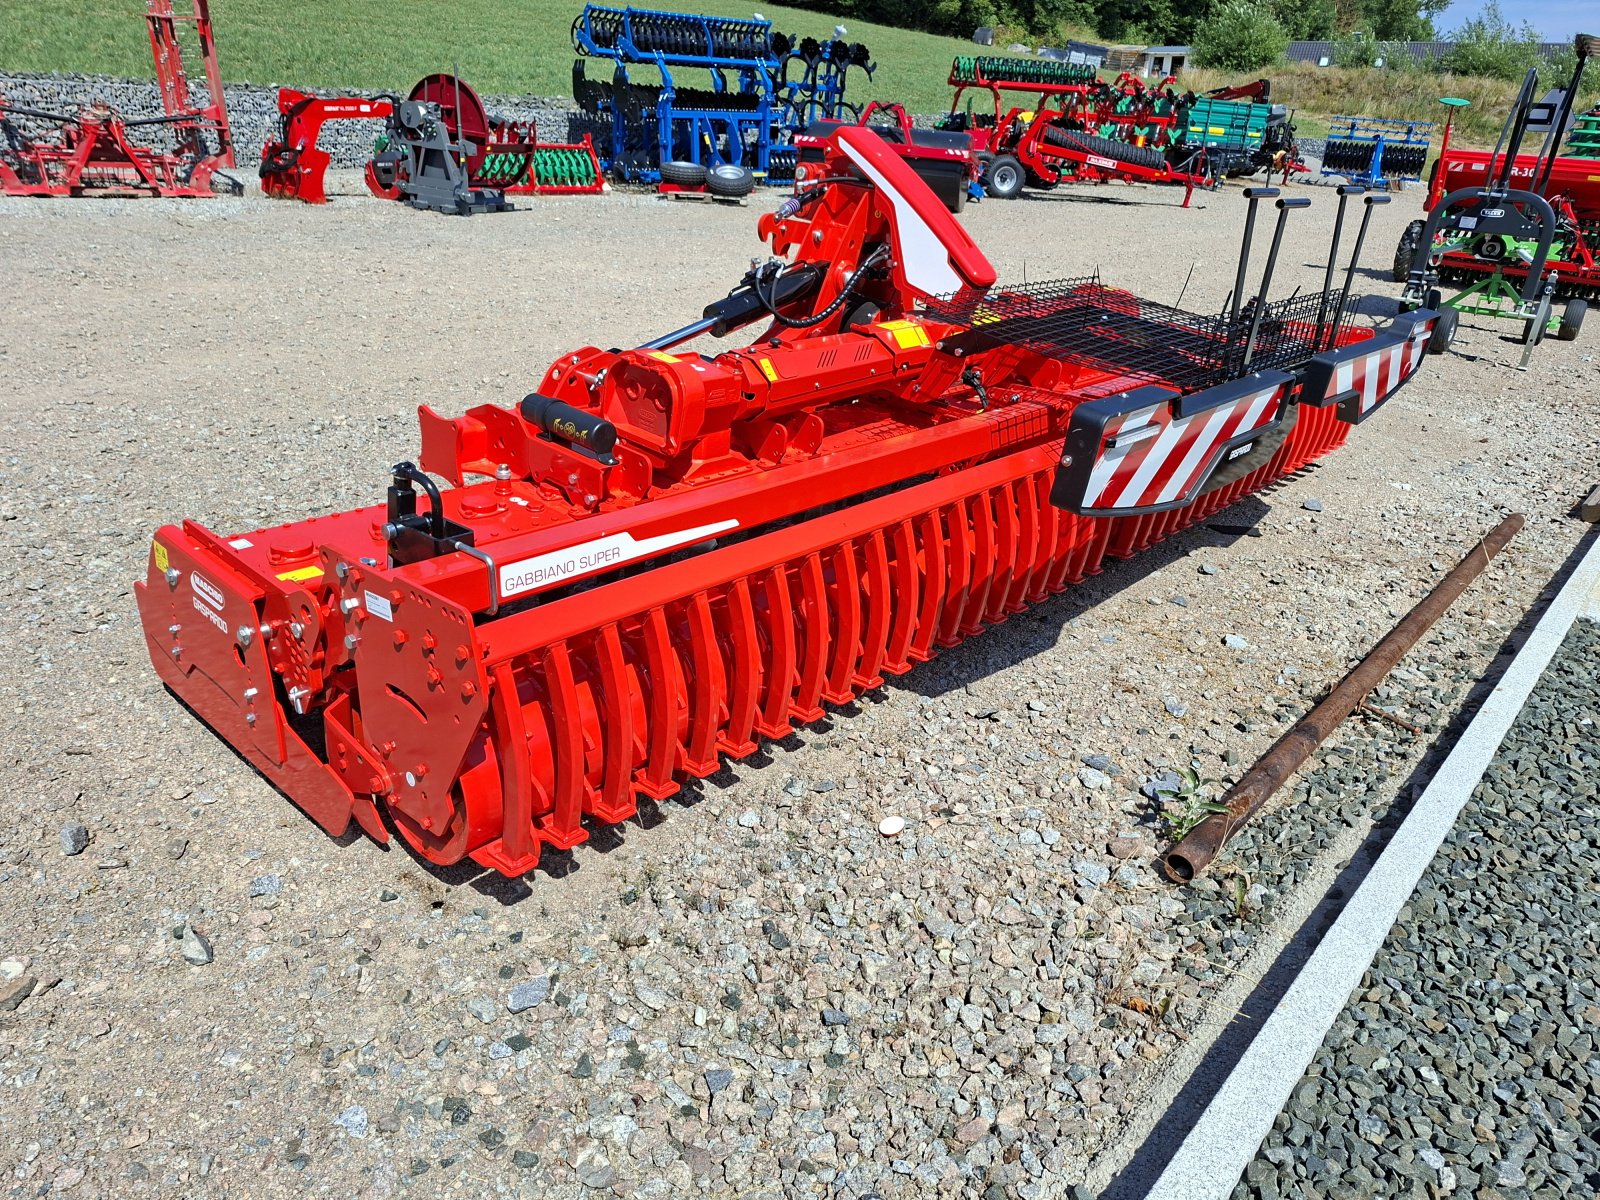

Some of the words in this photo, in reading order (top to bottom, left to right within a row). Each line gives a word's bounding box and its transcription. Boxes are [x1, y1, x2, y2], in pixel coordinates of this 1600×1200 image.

[505, 560, 575, 592] GABBIANO
[579, 546, 621, 569] SUPER
[193, 574, 224, 604] MASCHIO
[192, 596, 228, 635] GASPARDO
